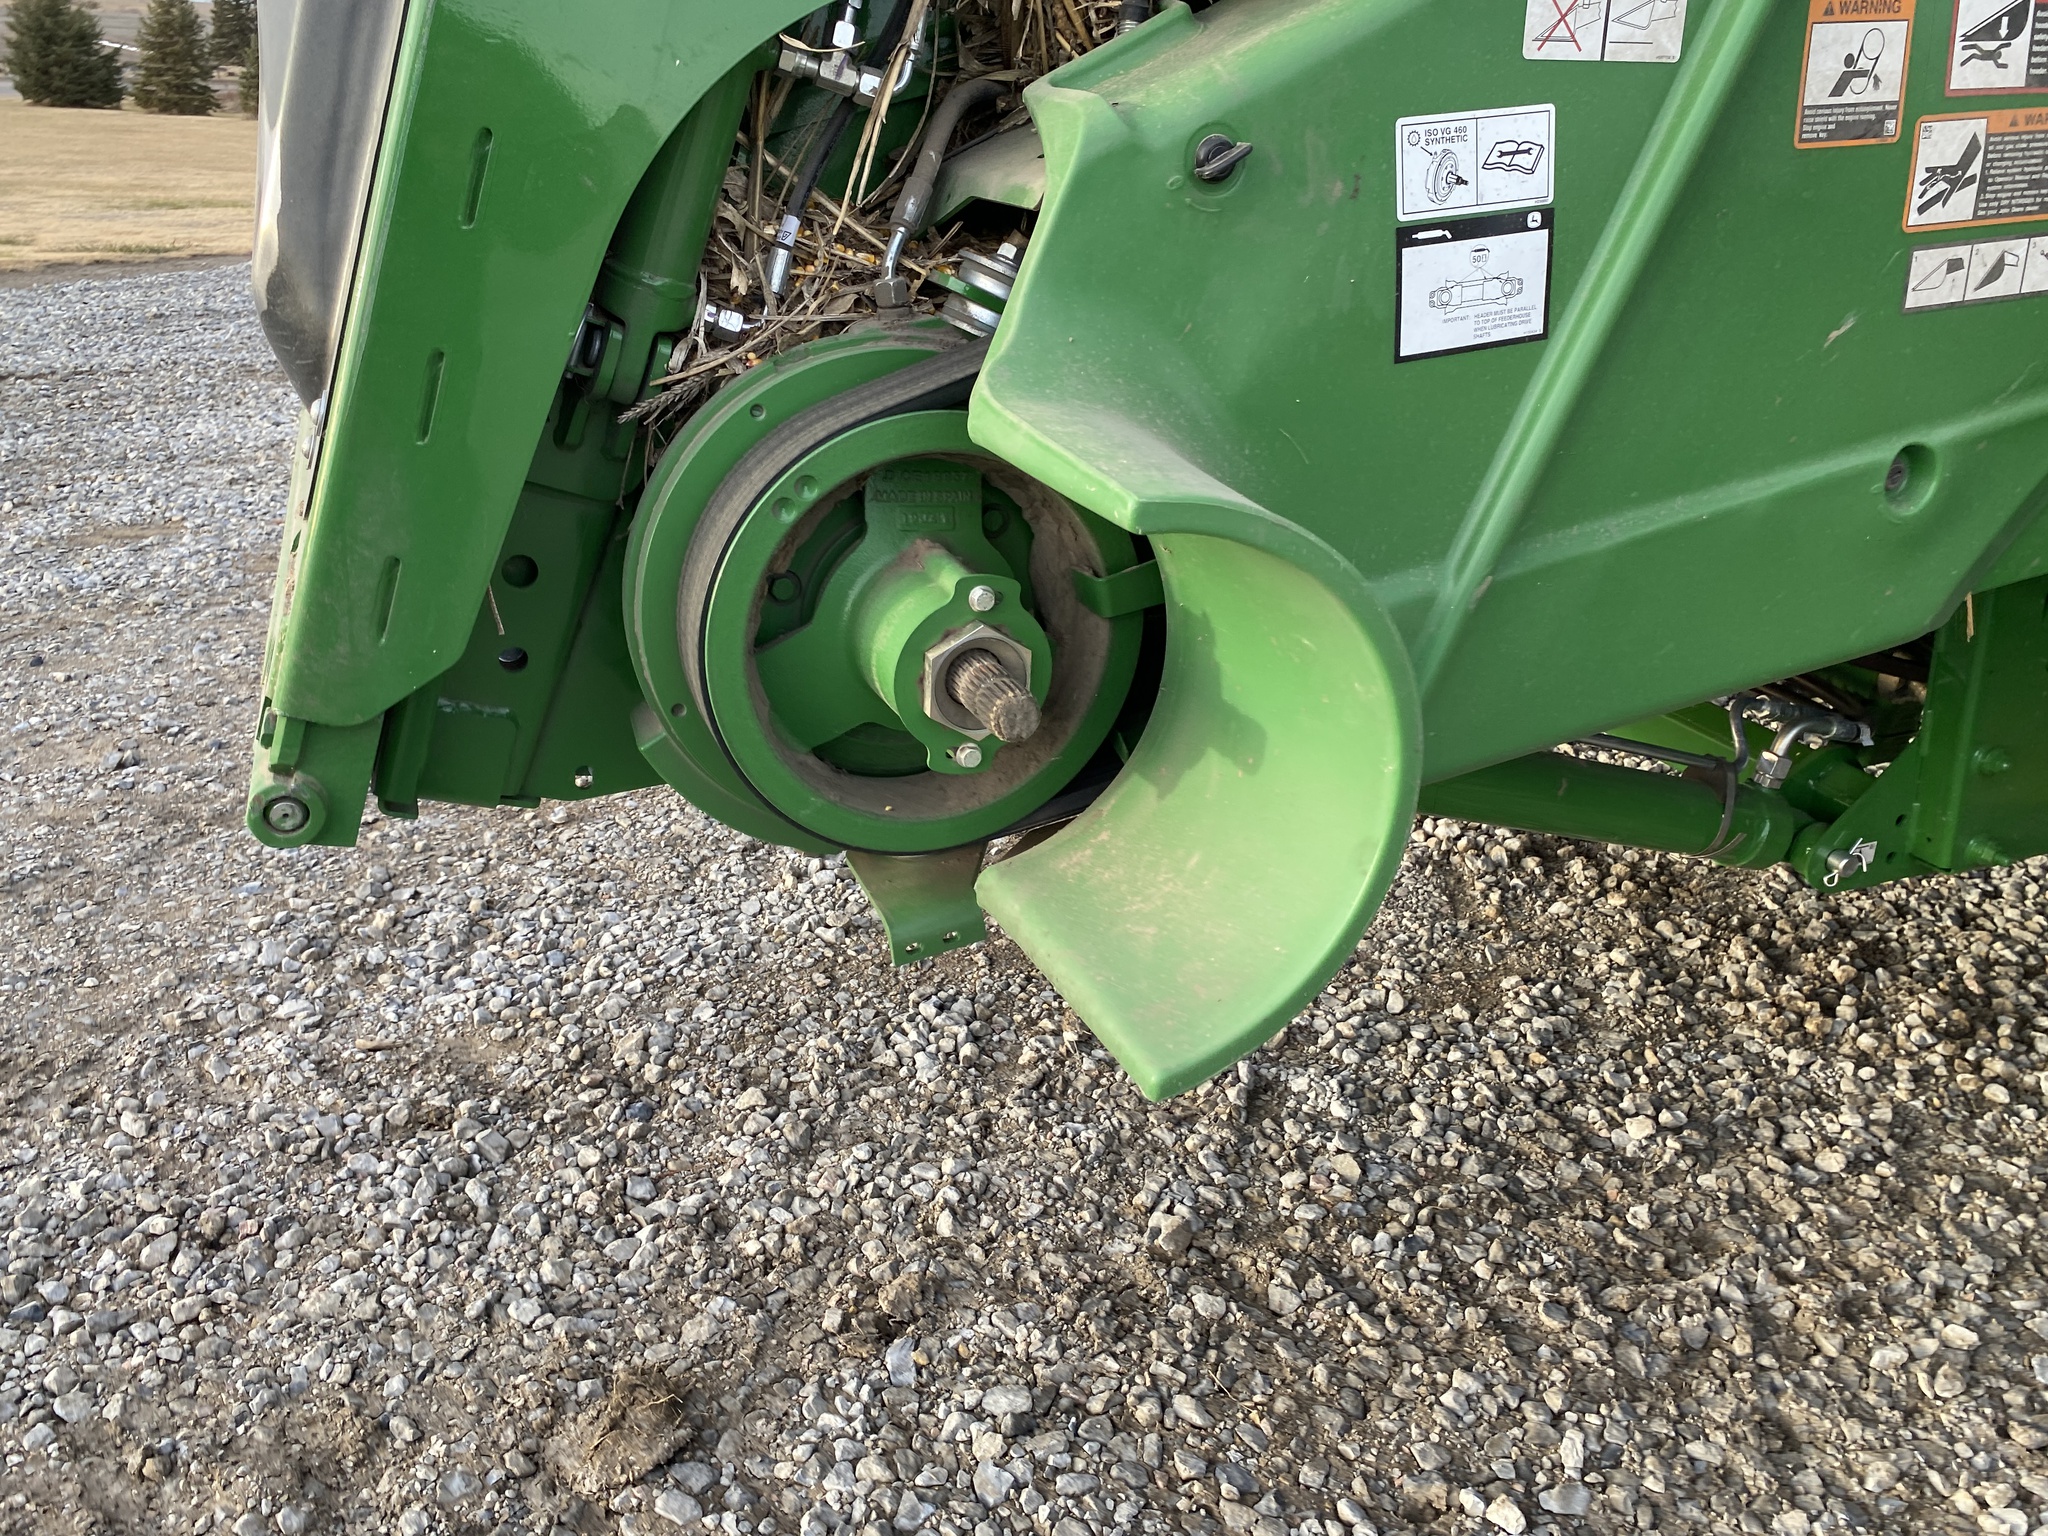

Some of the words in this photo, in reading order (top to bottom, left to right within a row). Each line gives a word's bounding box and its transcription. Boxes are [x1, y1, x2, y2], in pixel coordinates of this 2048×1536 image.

[1840, 0, 1902, 15] WARNING
[1424, 128, 1439, 138] ISO
[1440, 127, 1452, 136] VG
[1453, 125, 1467, 134] 460
[1424, 134, 1468, 147] SYNTHETIC
[1473, 310, 1493, 319] HEADER
[1493, 309, 1507, 317] MUST
[1514, 304, 1537, 313] PARALLEL
[1497, 312, 1531, 322] FEEDERHOUSE
[1442, 314, 1471, 324] IMPORTANT:
[1487, 321, 1518, 330] LUBRICATING
[1518, 318, 1532, 326] DRIVE
